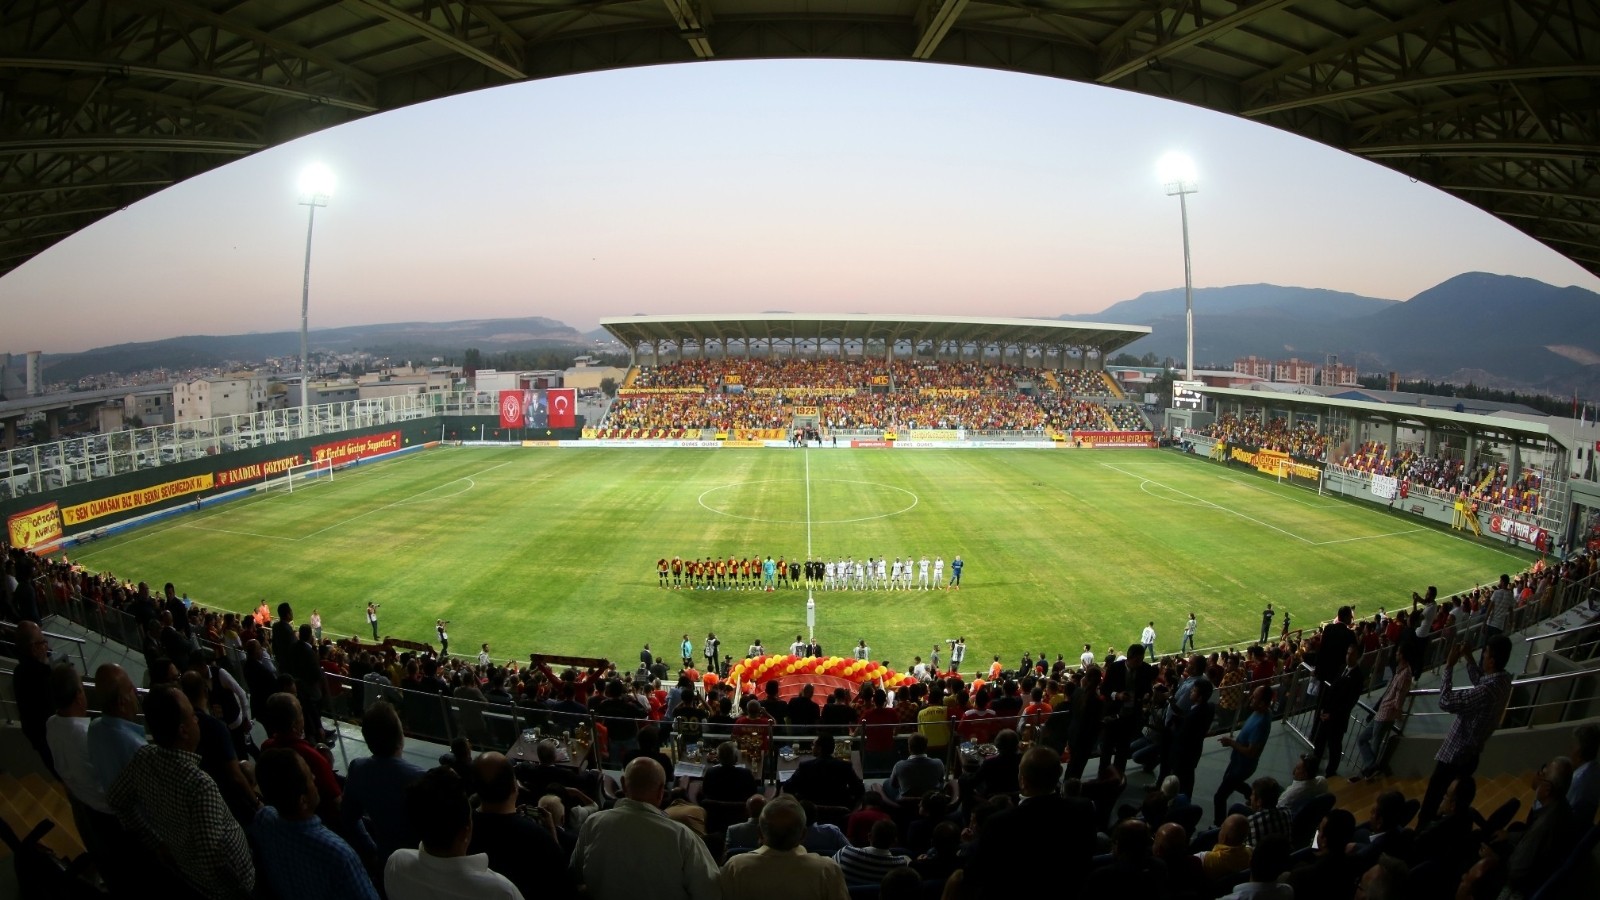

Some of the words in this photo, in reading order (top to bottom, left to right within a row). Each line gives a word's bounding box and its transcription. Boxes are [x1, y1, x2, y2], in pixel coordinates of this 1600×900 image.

[796, 407, 817, 415] 1925
[230, 464, 261, 482] İNADINA
[264, 457, 294, 474] GÖZTEPE
[76, 508, 88, 520] SEN
[90, 498, 120, 515] OLMASAN
[122, 496, 132, 508] BİZ
[134, 494, 142, 505] BU
